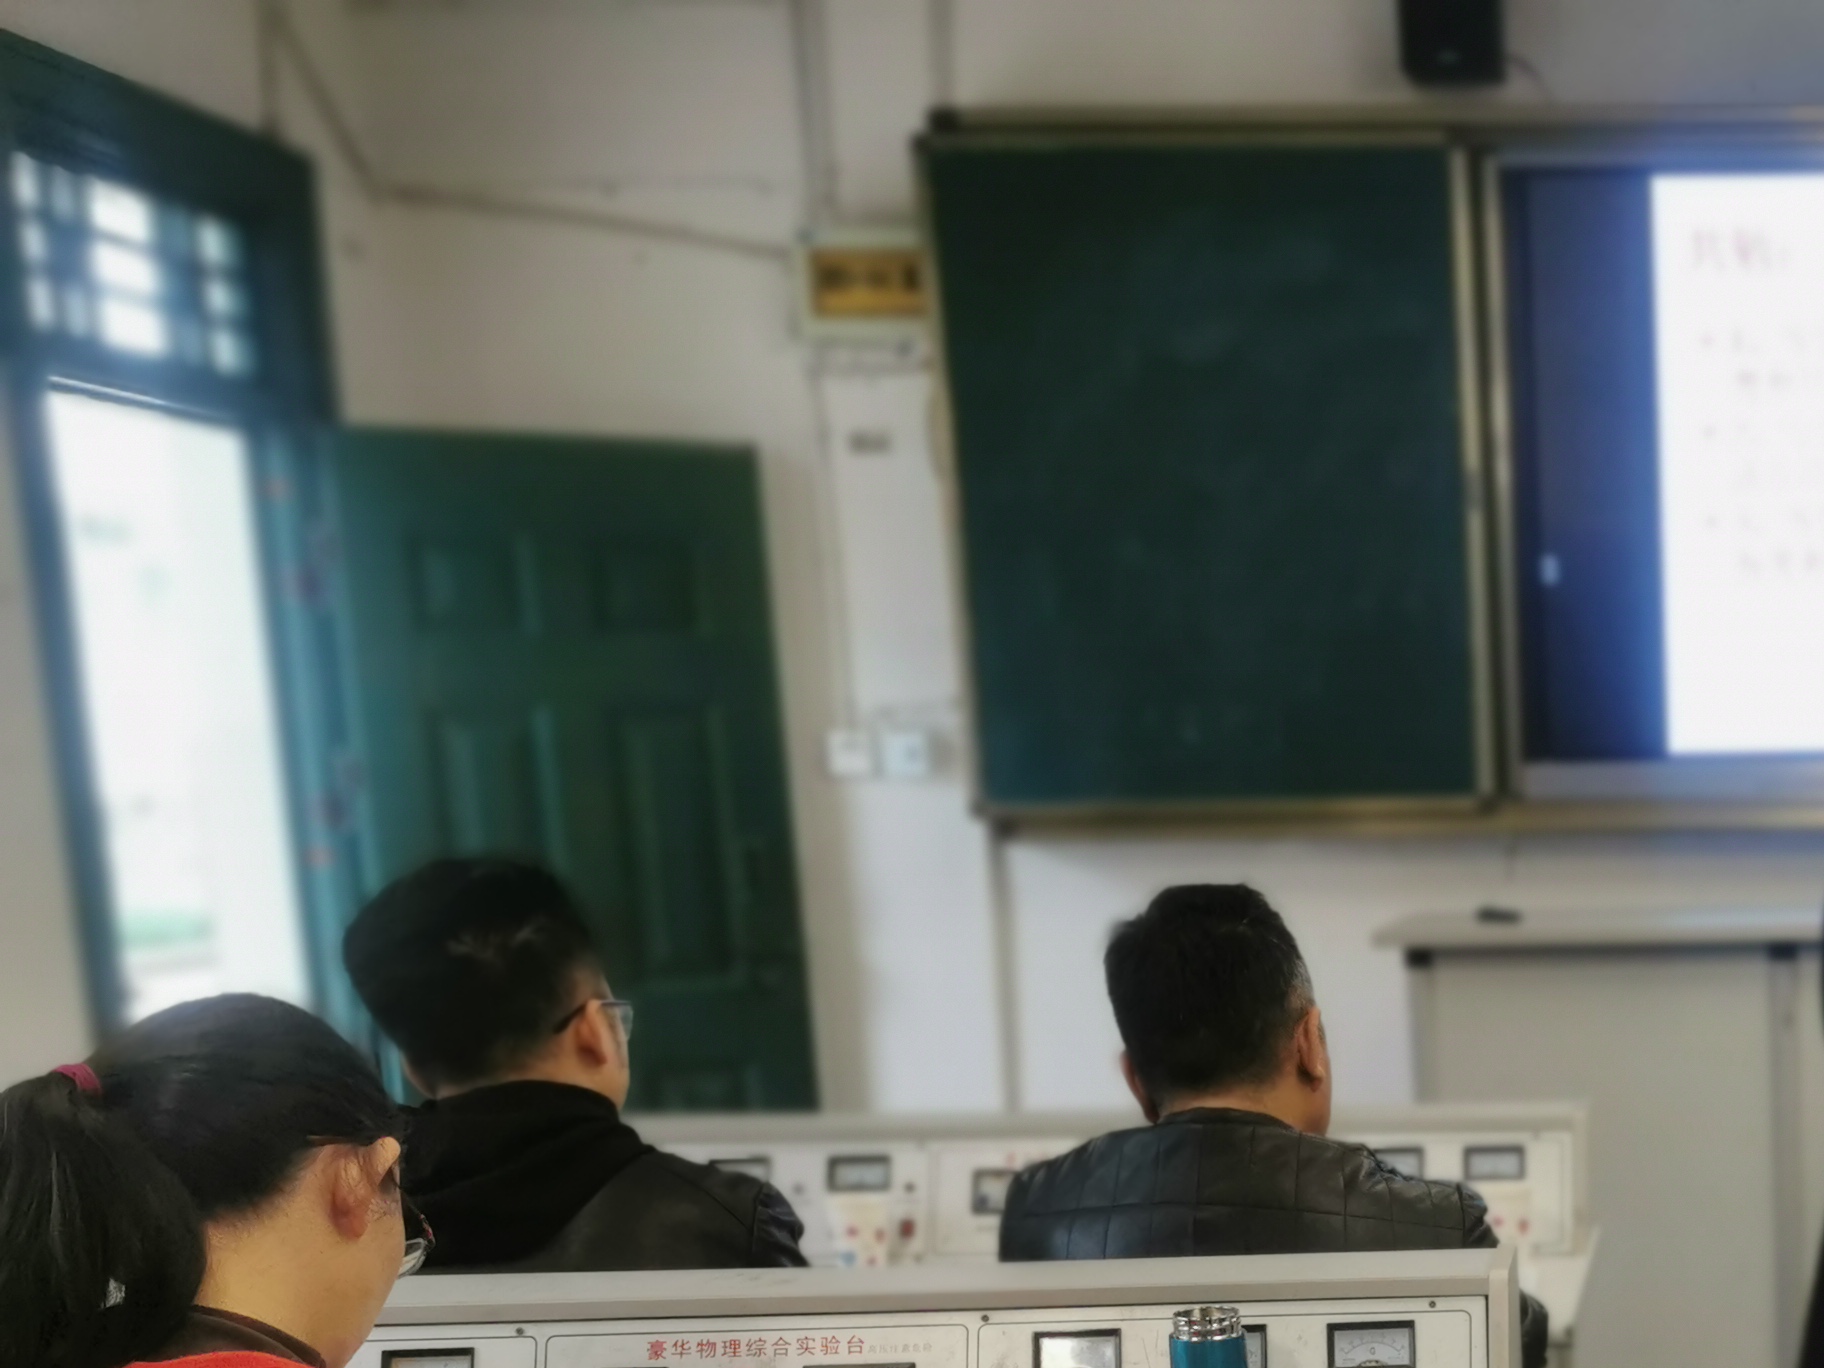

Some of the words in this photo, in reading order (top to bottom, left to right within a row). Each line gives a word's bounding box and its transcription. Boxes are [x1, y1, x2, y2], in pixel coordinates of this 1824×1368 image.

[647, 1335, 865, 1361] 豪华物理综合实验台
